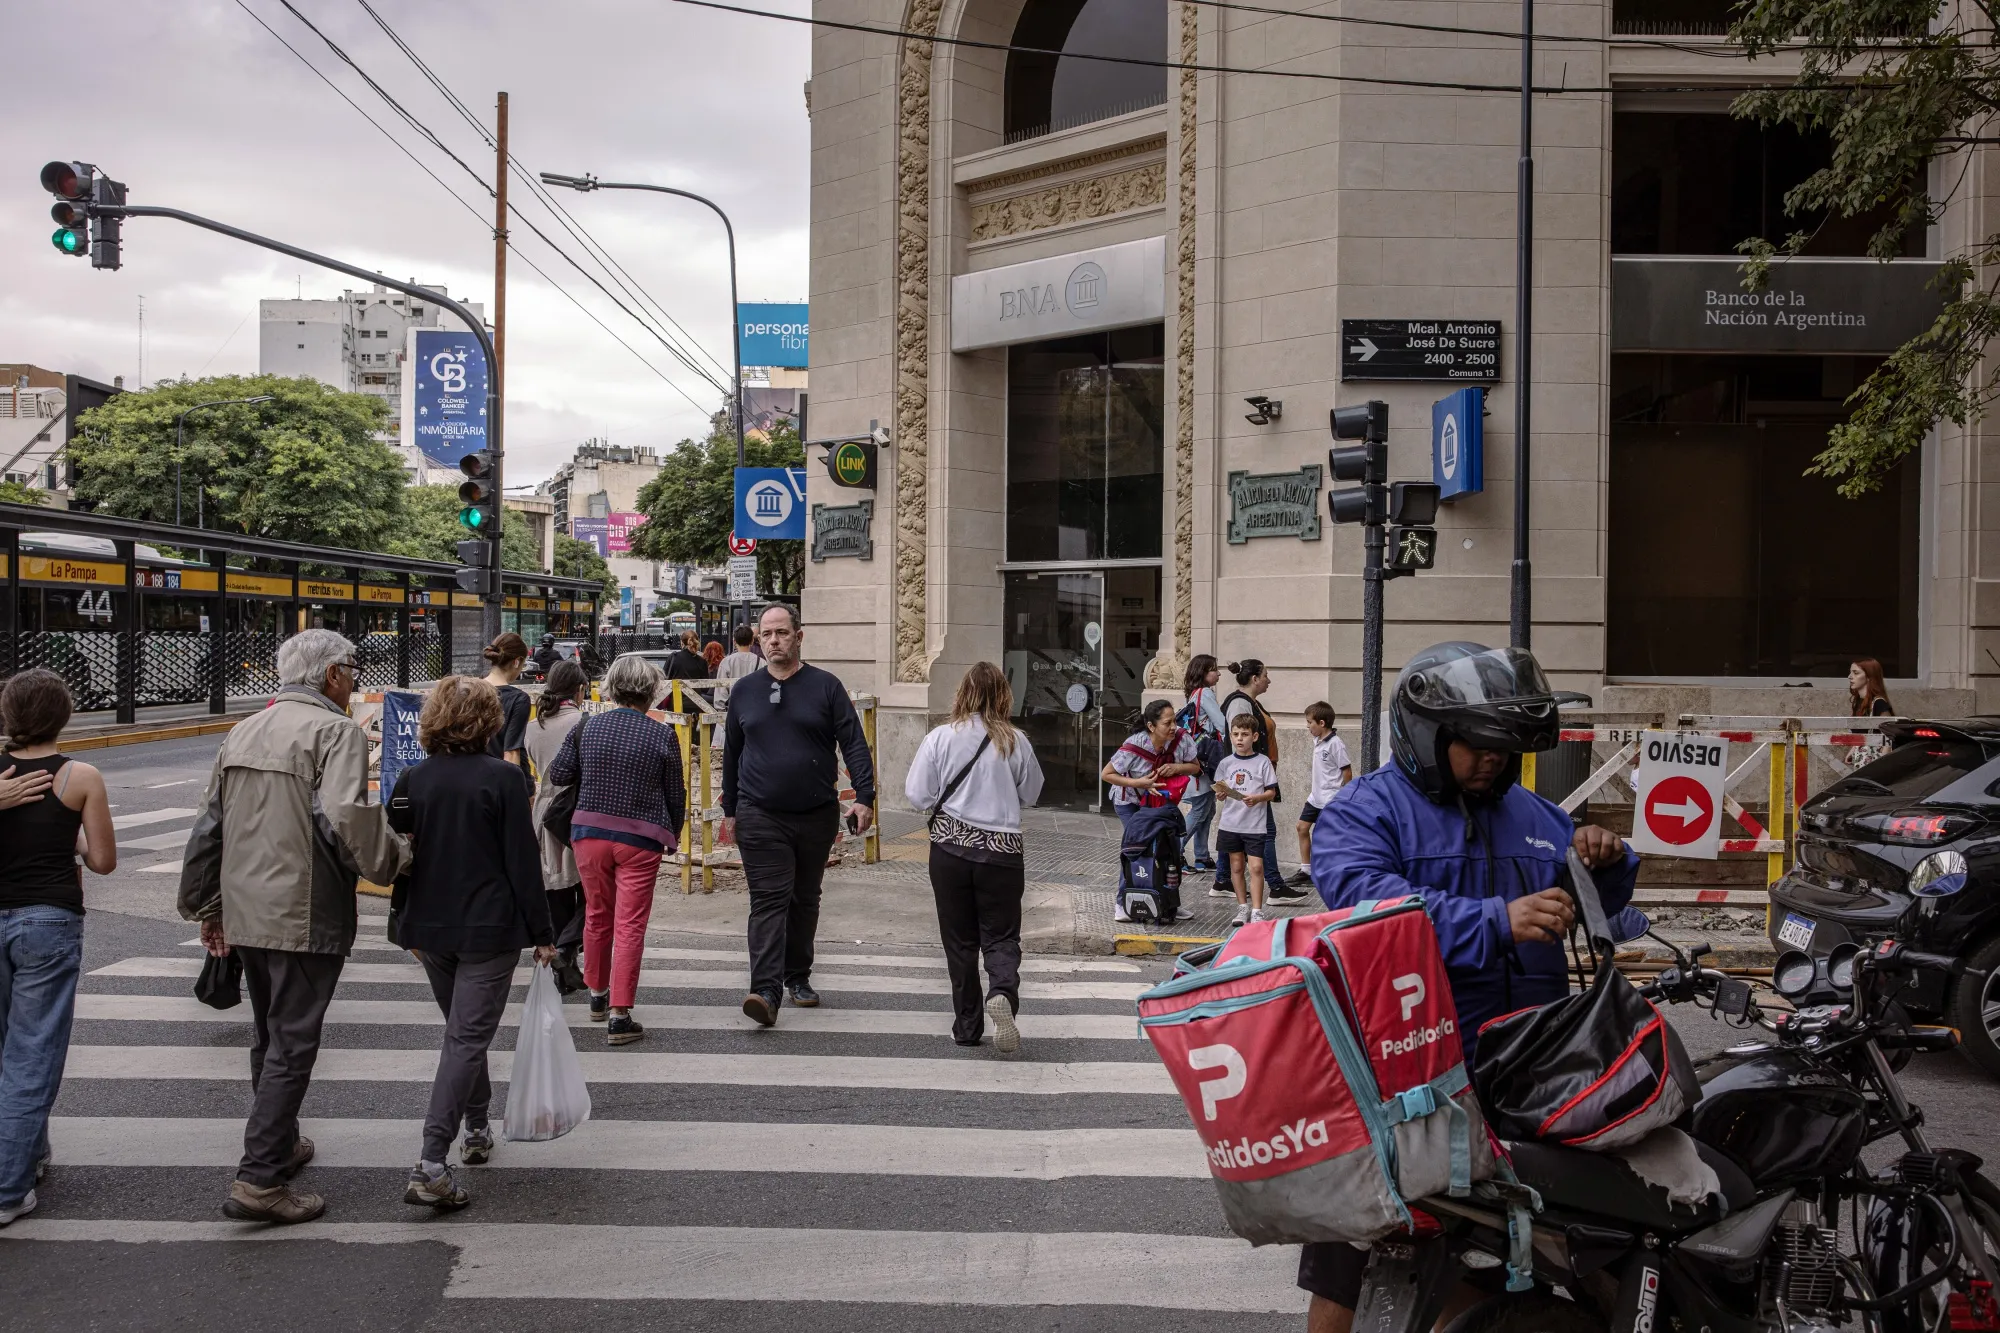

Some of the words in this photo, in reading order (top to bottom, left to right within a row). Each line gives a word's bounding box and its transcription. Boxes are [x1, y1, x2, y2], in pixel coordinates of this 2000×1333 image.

[1000, 283, 1060, 321] BNA
[1705, 290, 1760, 306] Banco
[1763, 290, 1785, 306] de
[1789, 290, 1806, 306] la
[1704, 309, 1768, 326] Nación
[1774, 310, 1867, 331] Argentina
[744, 323, 809, 338] persona
[1408, 322, 1442, 335] Mcal.
[1446, 323, 1496, 335] Antonio
[1406, 336, 1436, 349] José
[1439, 337, 1456, 349] De
[1459, 337, 1496, 349] Sucre
[1424, 353, 1455, 365] 2400
[1465, 353, 1496, 365] 2500
[430, 352, 467, 393] CB
[1448, 369, 1483, 378] Comuna
[1485, 369, 1495, 378] 13
[421, 425, 486, 436] INMOBILIARIA
[1238, 486, 1263, 510] BANCO
[1246, 510, 1302, 528] ARGENTINA
[823, 536, 860, 550] ARGENTINA
[51, 562, 62, 577] La
[65, 563, 97, 580] Pampa
[136, 573, 145, 586] 80
[151, 574, 163, 587] 168
[167, 576, 179, 588] 184
[371, 588, 376, 599] La
[377, 589, 392, 601] Pampa
[77, 589, 113, 622] 44
[398, 725, 412, 736] LA
[397, 740, 409, 750] LA
[1648, 741, 1721, 767] DESVIO
[1787, 1073, 1838, 1086] Keller
[1205, 1118, 1329, 1169] edidosYa
